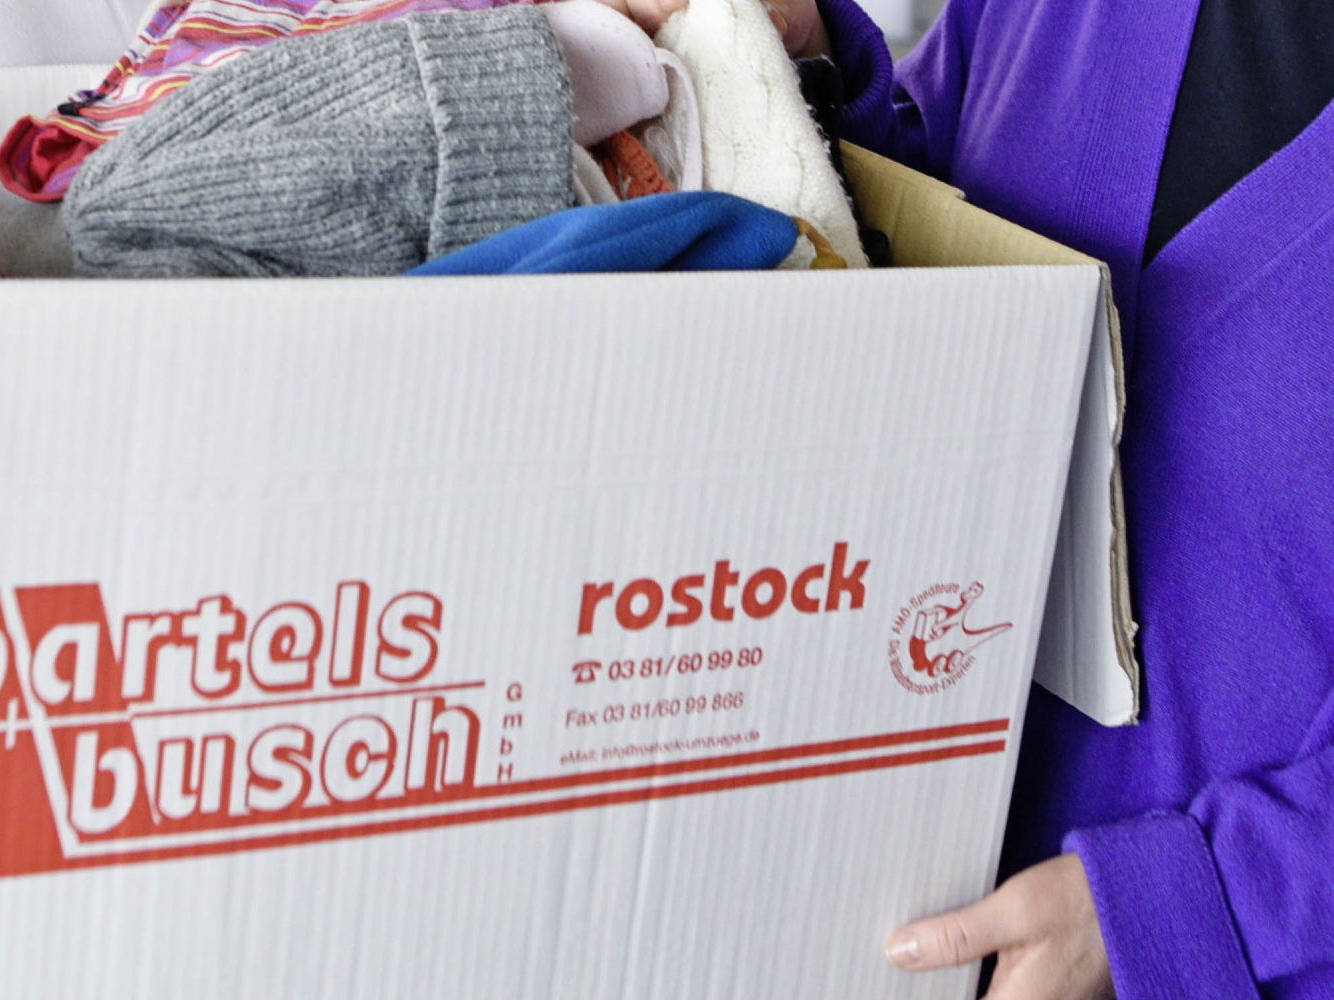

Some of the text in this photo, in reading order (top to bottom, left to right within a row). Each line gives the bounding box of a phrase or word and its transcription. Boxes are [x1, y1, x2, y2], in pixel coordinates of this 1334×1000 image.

[577, 541, 871, 636] rostock
[608, 646, 763, 681] 03 81/60 99 80
[497, 681, 523, 783] GmbH
[565, 708, 597, 728] Fax
[602, 704, 625, 724] 03
[630, 699, 681, 721] 81/60
[685, 695, 707, 715] 99
[70, 695, 481, 834] busch
